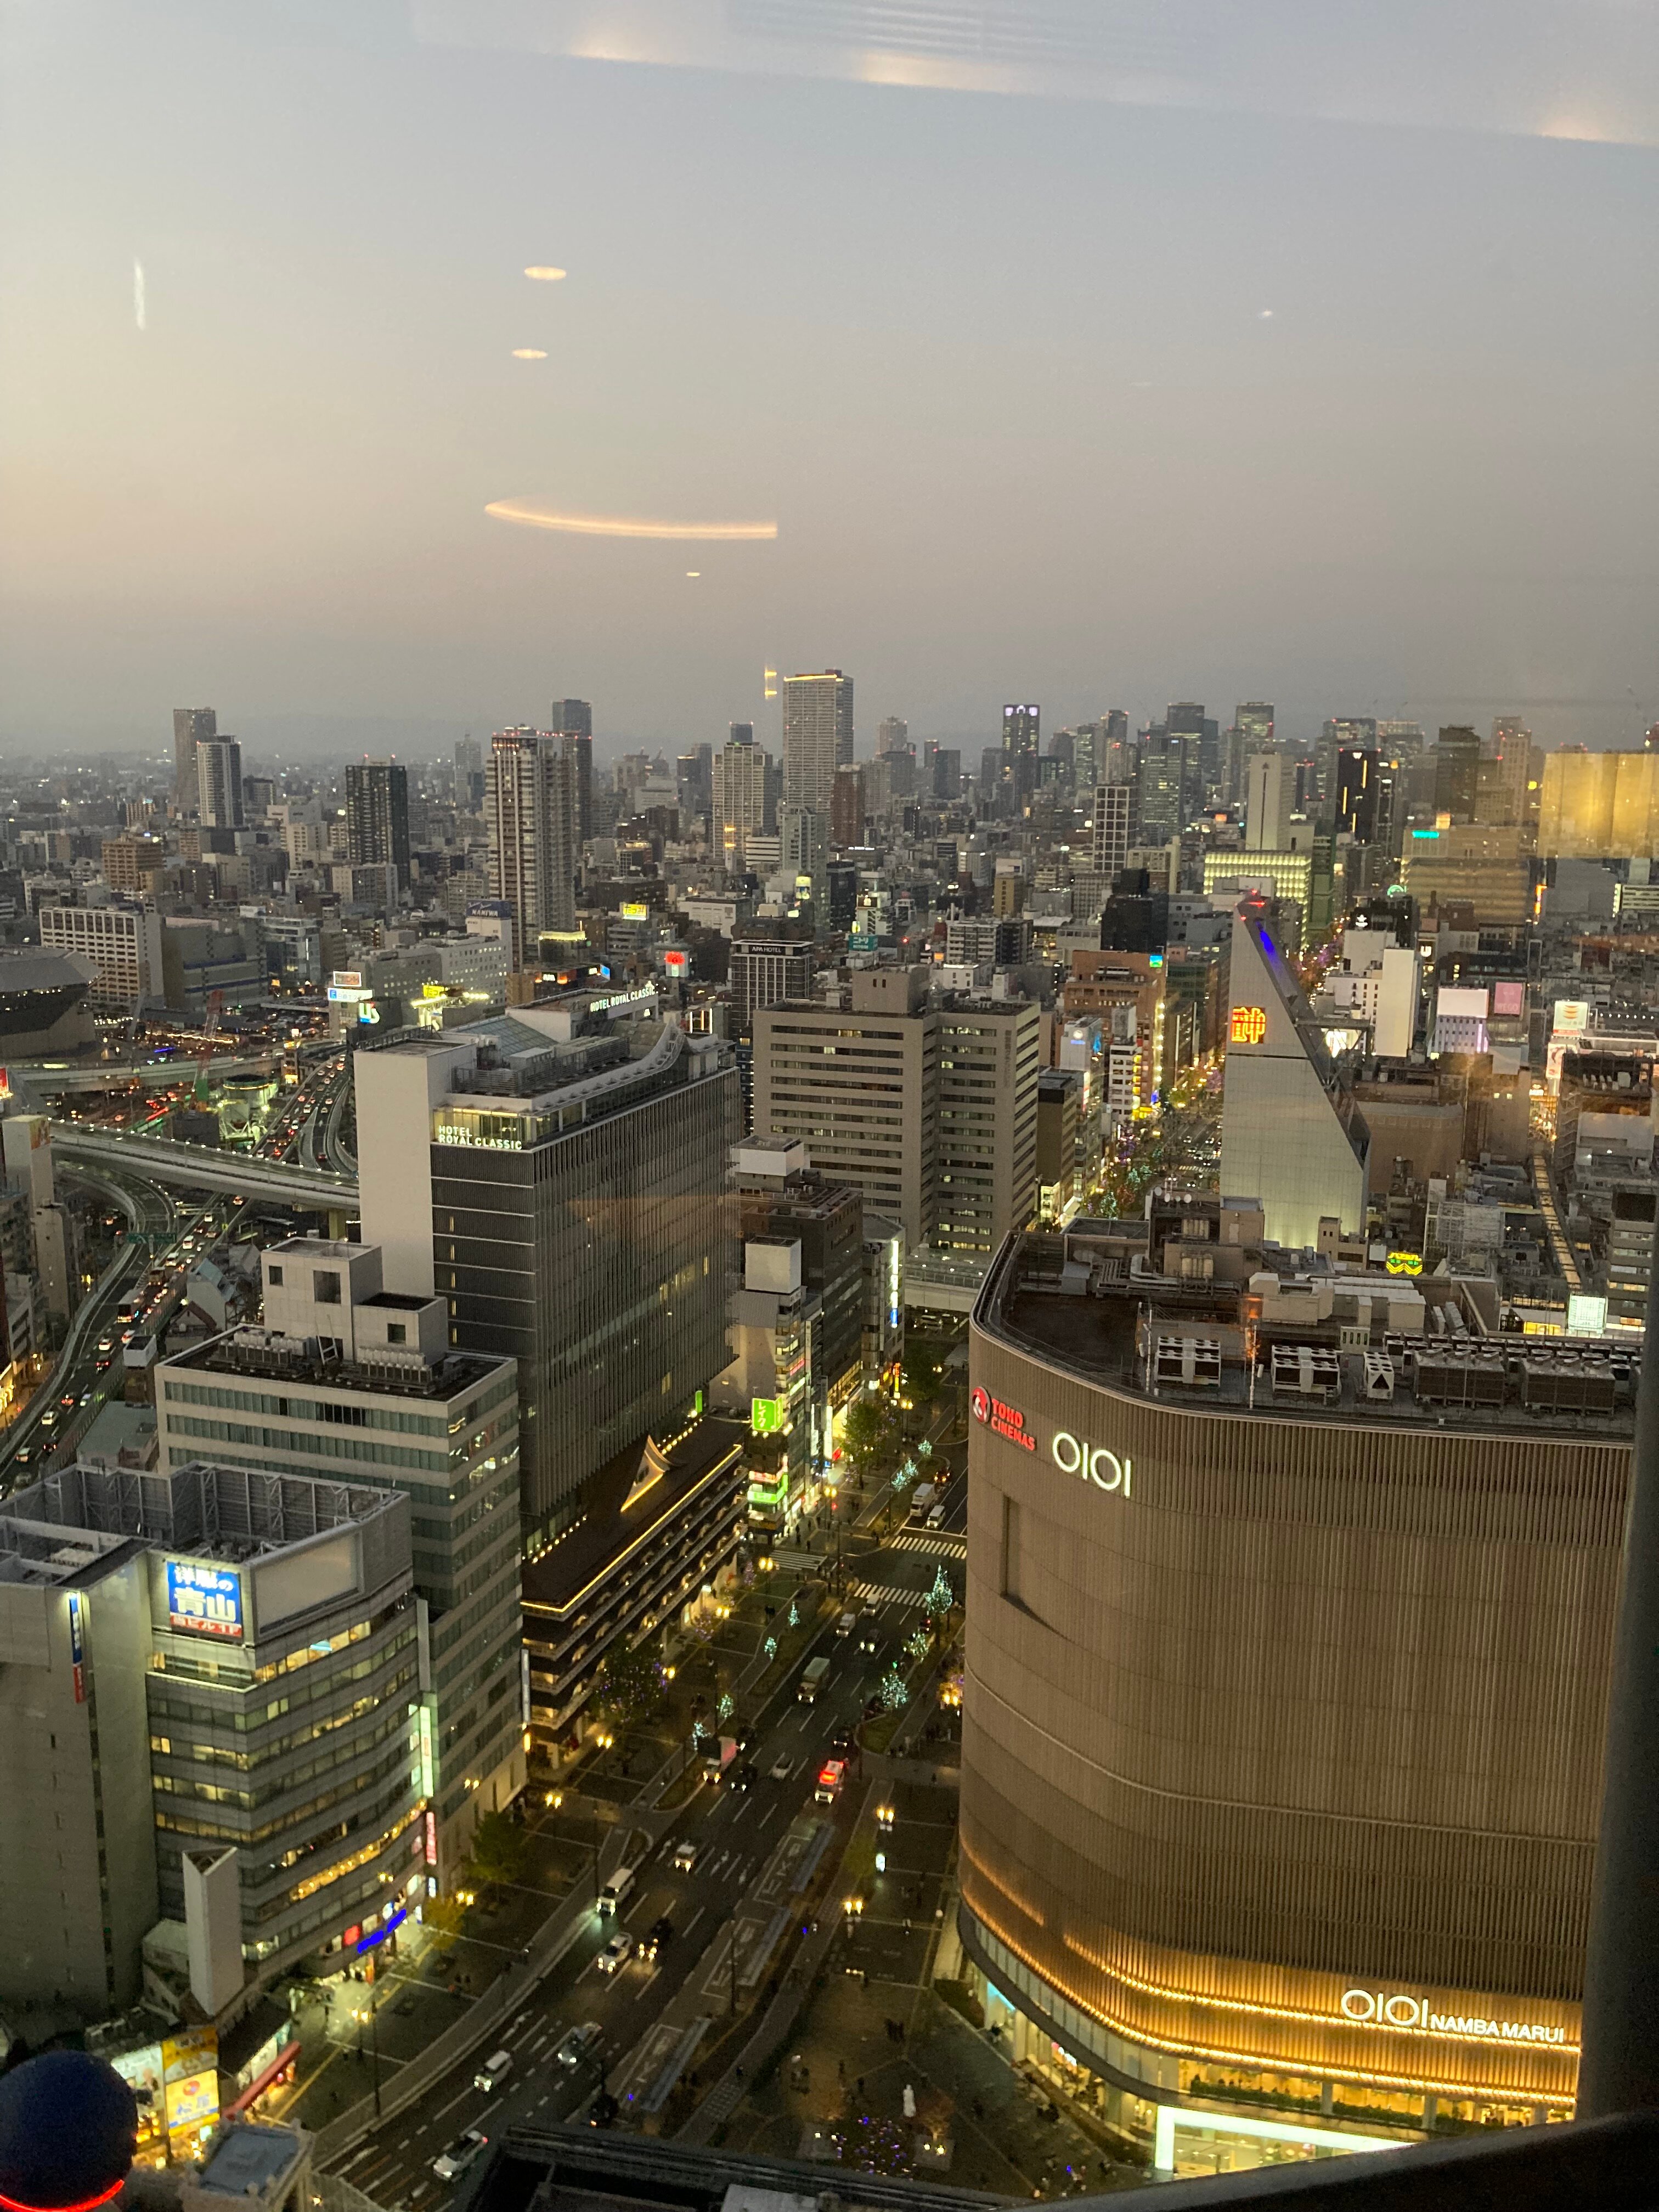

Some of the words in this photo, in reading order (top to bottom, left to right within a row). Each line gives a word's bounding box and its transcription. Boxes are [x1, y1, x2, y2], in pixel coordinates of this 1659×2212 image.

[590, 997, 611, 1012] HOTEL
[611, 992, 630, 1007] ROYAL
[630, 985, 656, 1001] CLASSIC
[439, 1125, 473, 1137] HOTEL
[439, 1133, 473, 1146] ROYAL
[474, 1137, 522, 1150] CLASSIC
[758, 1401, 767, 1428] レイク
[991, 1398, 1024, 1429] TOHO
[991, 1416, 1036, 1452] CINEMAS
[173, 1587, 236, 1623] 青山
[1430, 2013, 1500, 2038] NAMBA
[1501, 2021, 1564, 2044] MARUI
